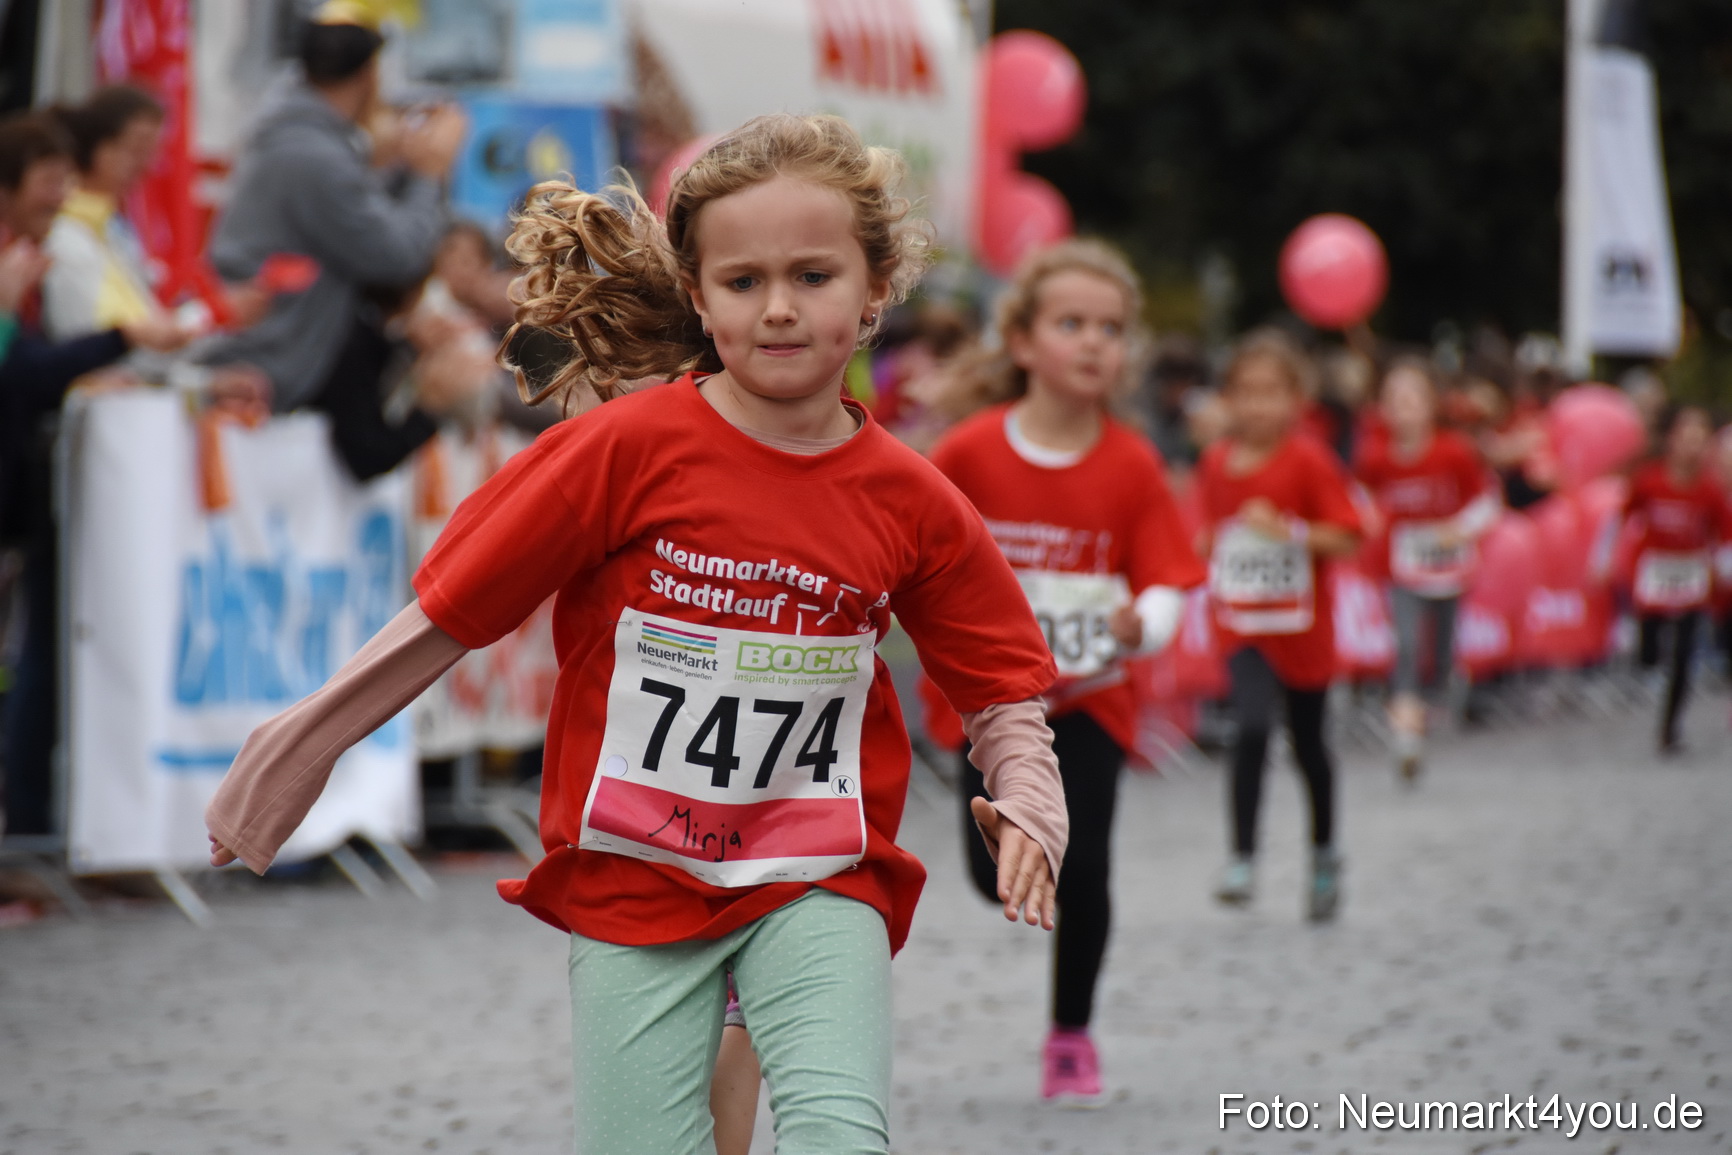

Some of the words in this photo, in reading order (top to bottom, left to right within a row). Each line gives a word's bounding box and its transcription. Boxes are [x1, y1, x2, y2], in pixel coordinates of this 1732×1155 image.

[655, 540, 829, 595] Neumarkter
[650, 568, 788, 625] Stadtlauf
[637, 641, 718, 671] NeuerMarkt
[641, 657, 667, 670] einkaufen
[669, 665, 684, 675] leben
[684, 670, 713, 681] genießen
[736, 641, 860, 674] BOCK
[734, 671, 775, 684] inspired
[778, 675, 790, 686] by
[792, 677, 819, 686] smart
[820, 675, 857, 685] concepts
[640, 677, 846, 789] 7474
[837, 778, 850, 795] K
[647, 804, 742, 862] Mirja
